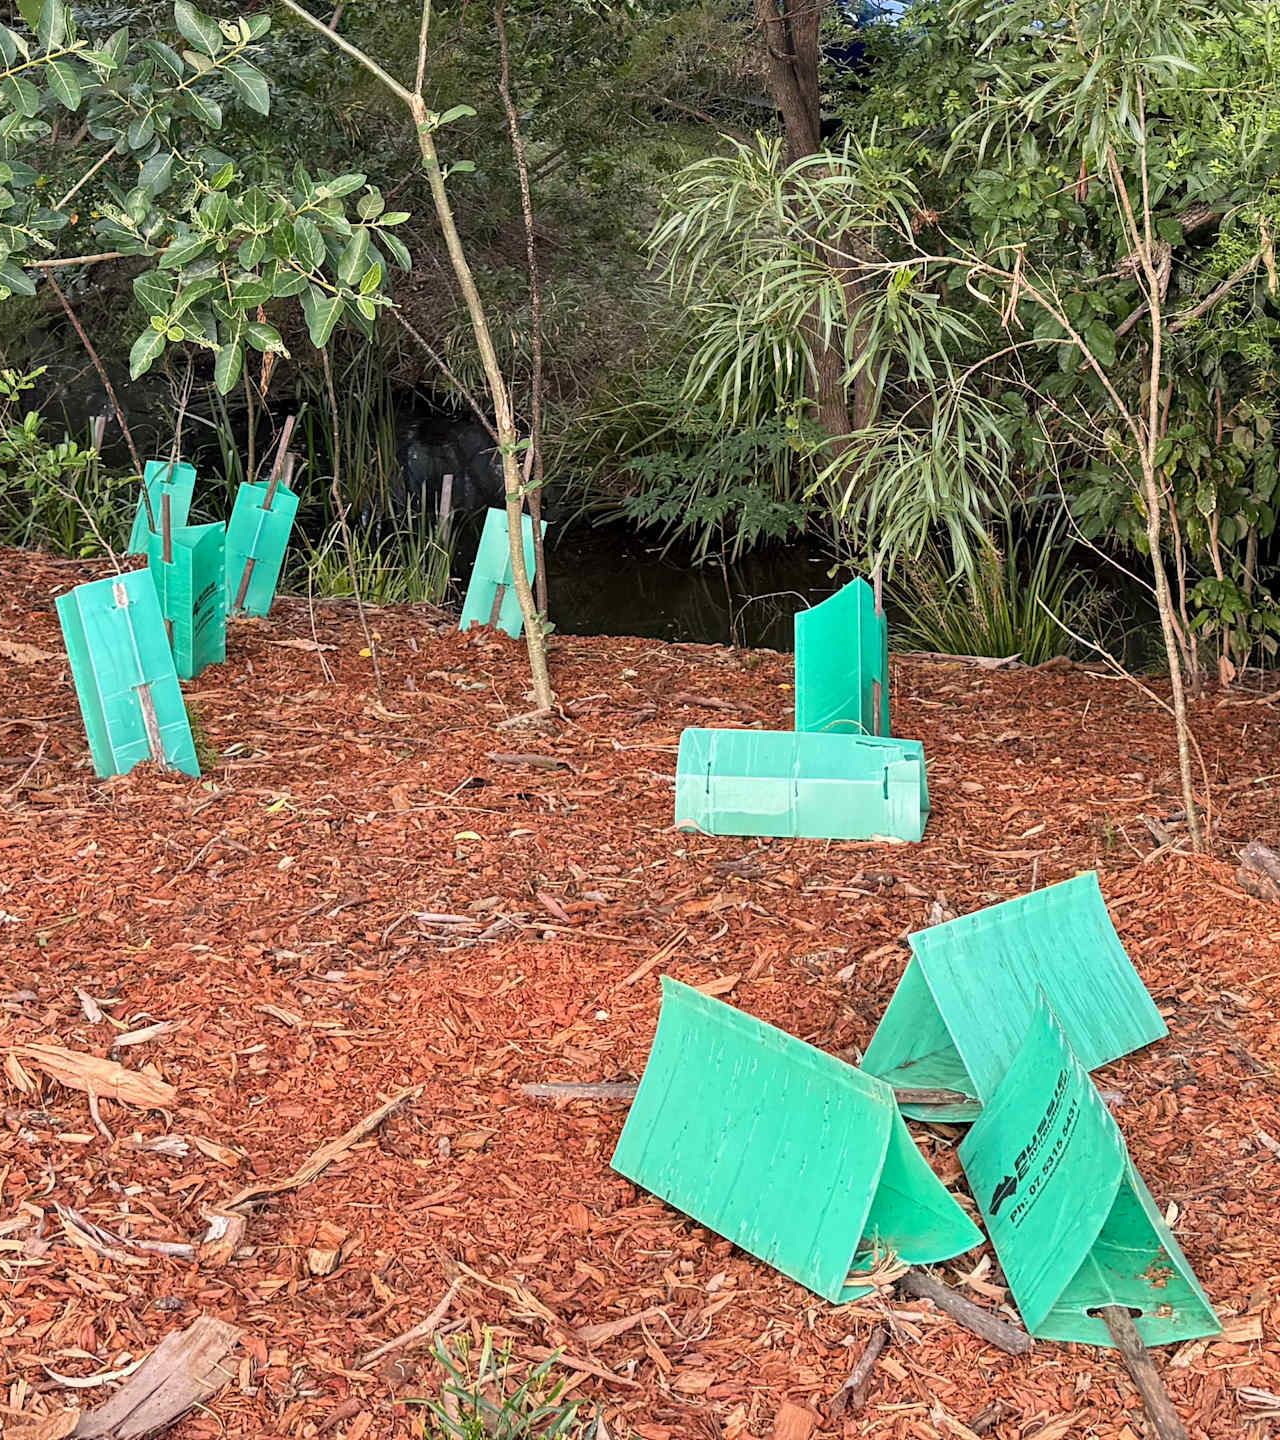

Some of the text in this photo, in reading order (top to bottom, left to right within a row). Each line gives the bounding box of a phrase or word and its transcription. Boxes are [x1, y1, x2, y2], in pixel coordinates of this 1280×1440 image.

[1010, 1098, 1077, 1222] Ph: 07 5315 5431
